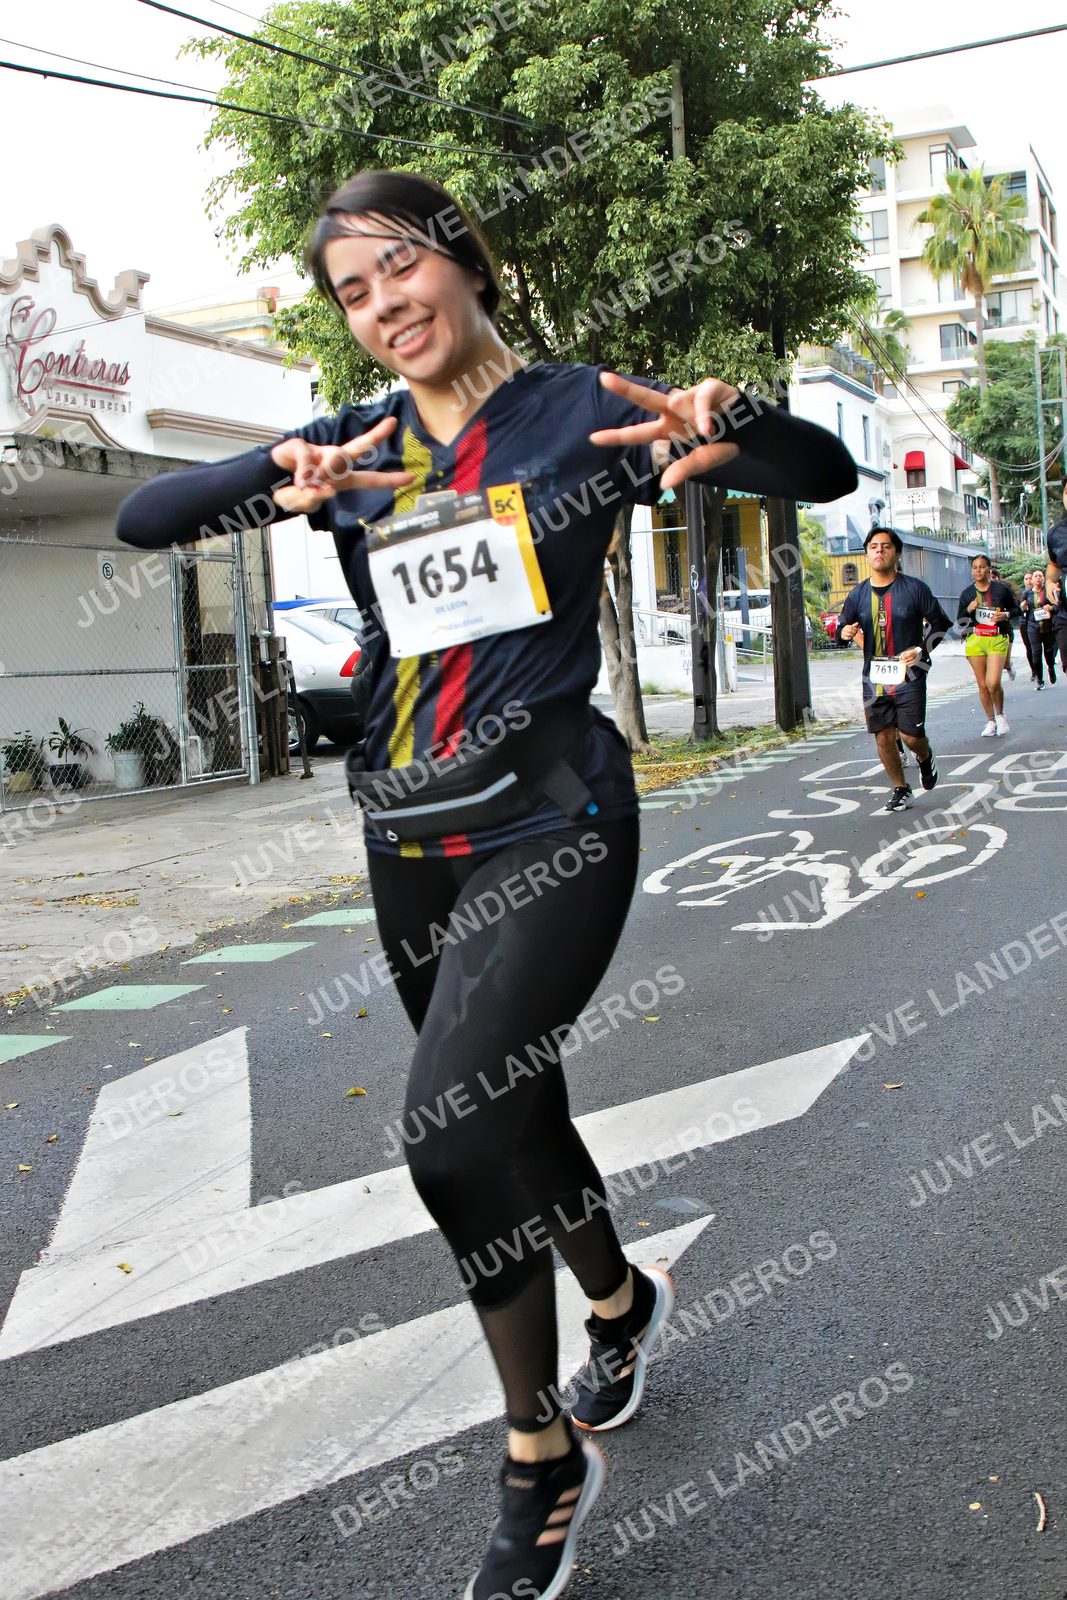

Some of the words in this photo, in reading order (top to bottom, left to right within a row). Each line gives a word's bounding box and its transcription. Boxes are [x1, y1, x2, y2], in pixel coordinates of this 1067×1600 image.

[494, 497, 517, 514] 5K
[391, 538, 499, 605] 1654
[875, 664, 899, 674] 7618
